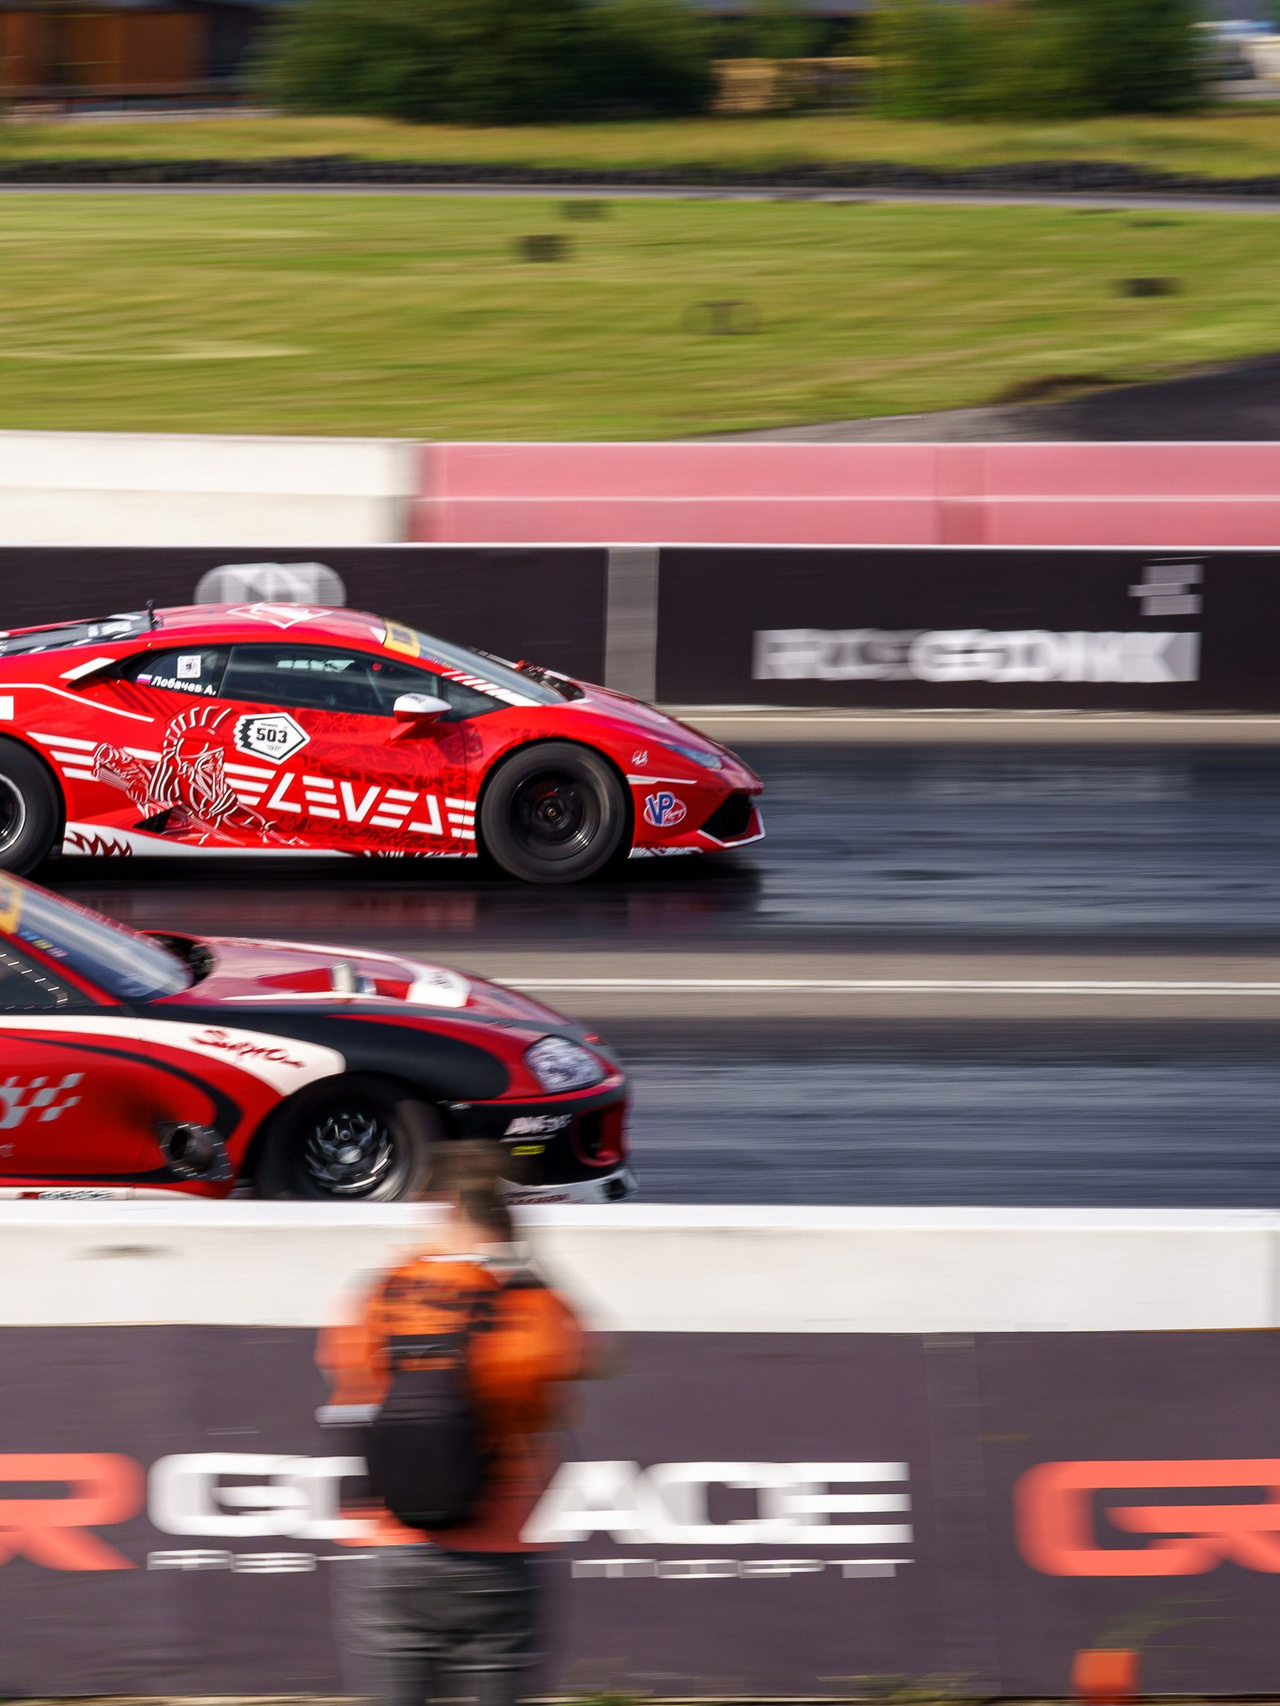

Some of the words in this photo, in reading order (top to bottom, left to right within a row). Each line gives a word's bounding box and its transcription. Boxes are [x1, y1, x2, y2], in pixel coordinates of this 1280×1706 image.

[151, 676, 204, 693] Лобачев
[256, 727, 288, 744] 503
[646, 792, 674, 825] VP
